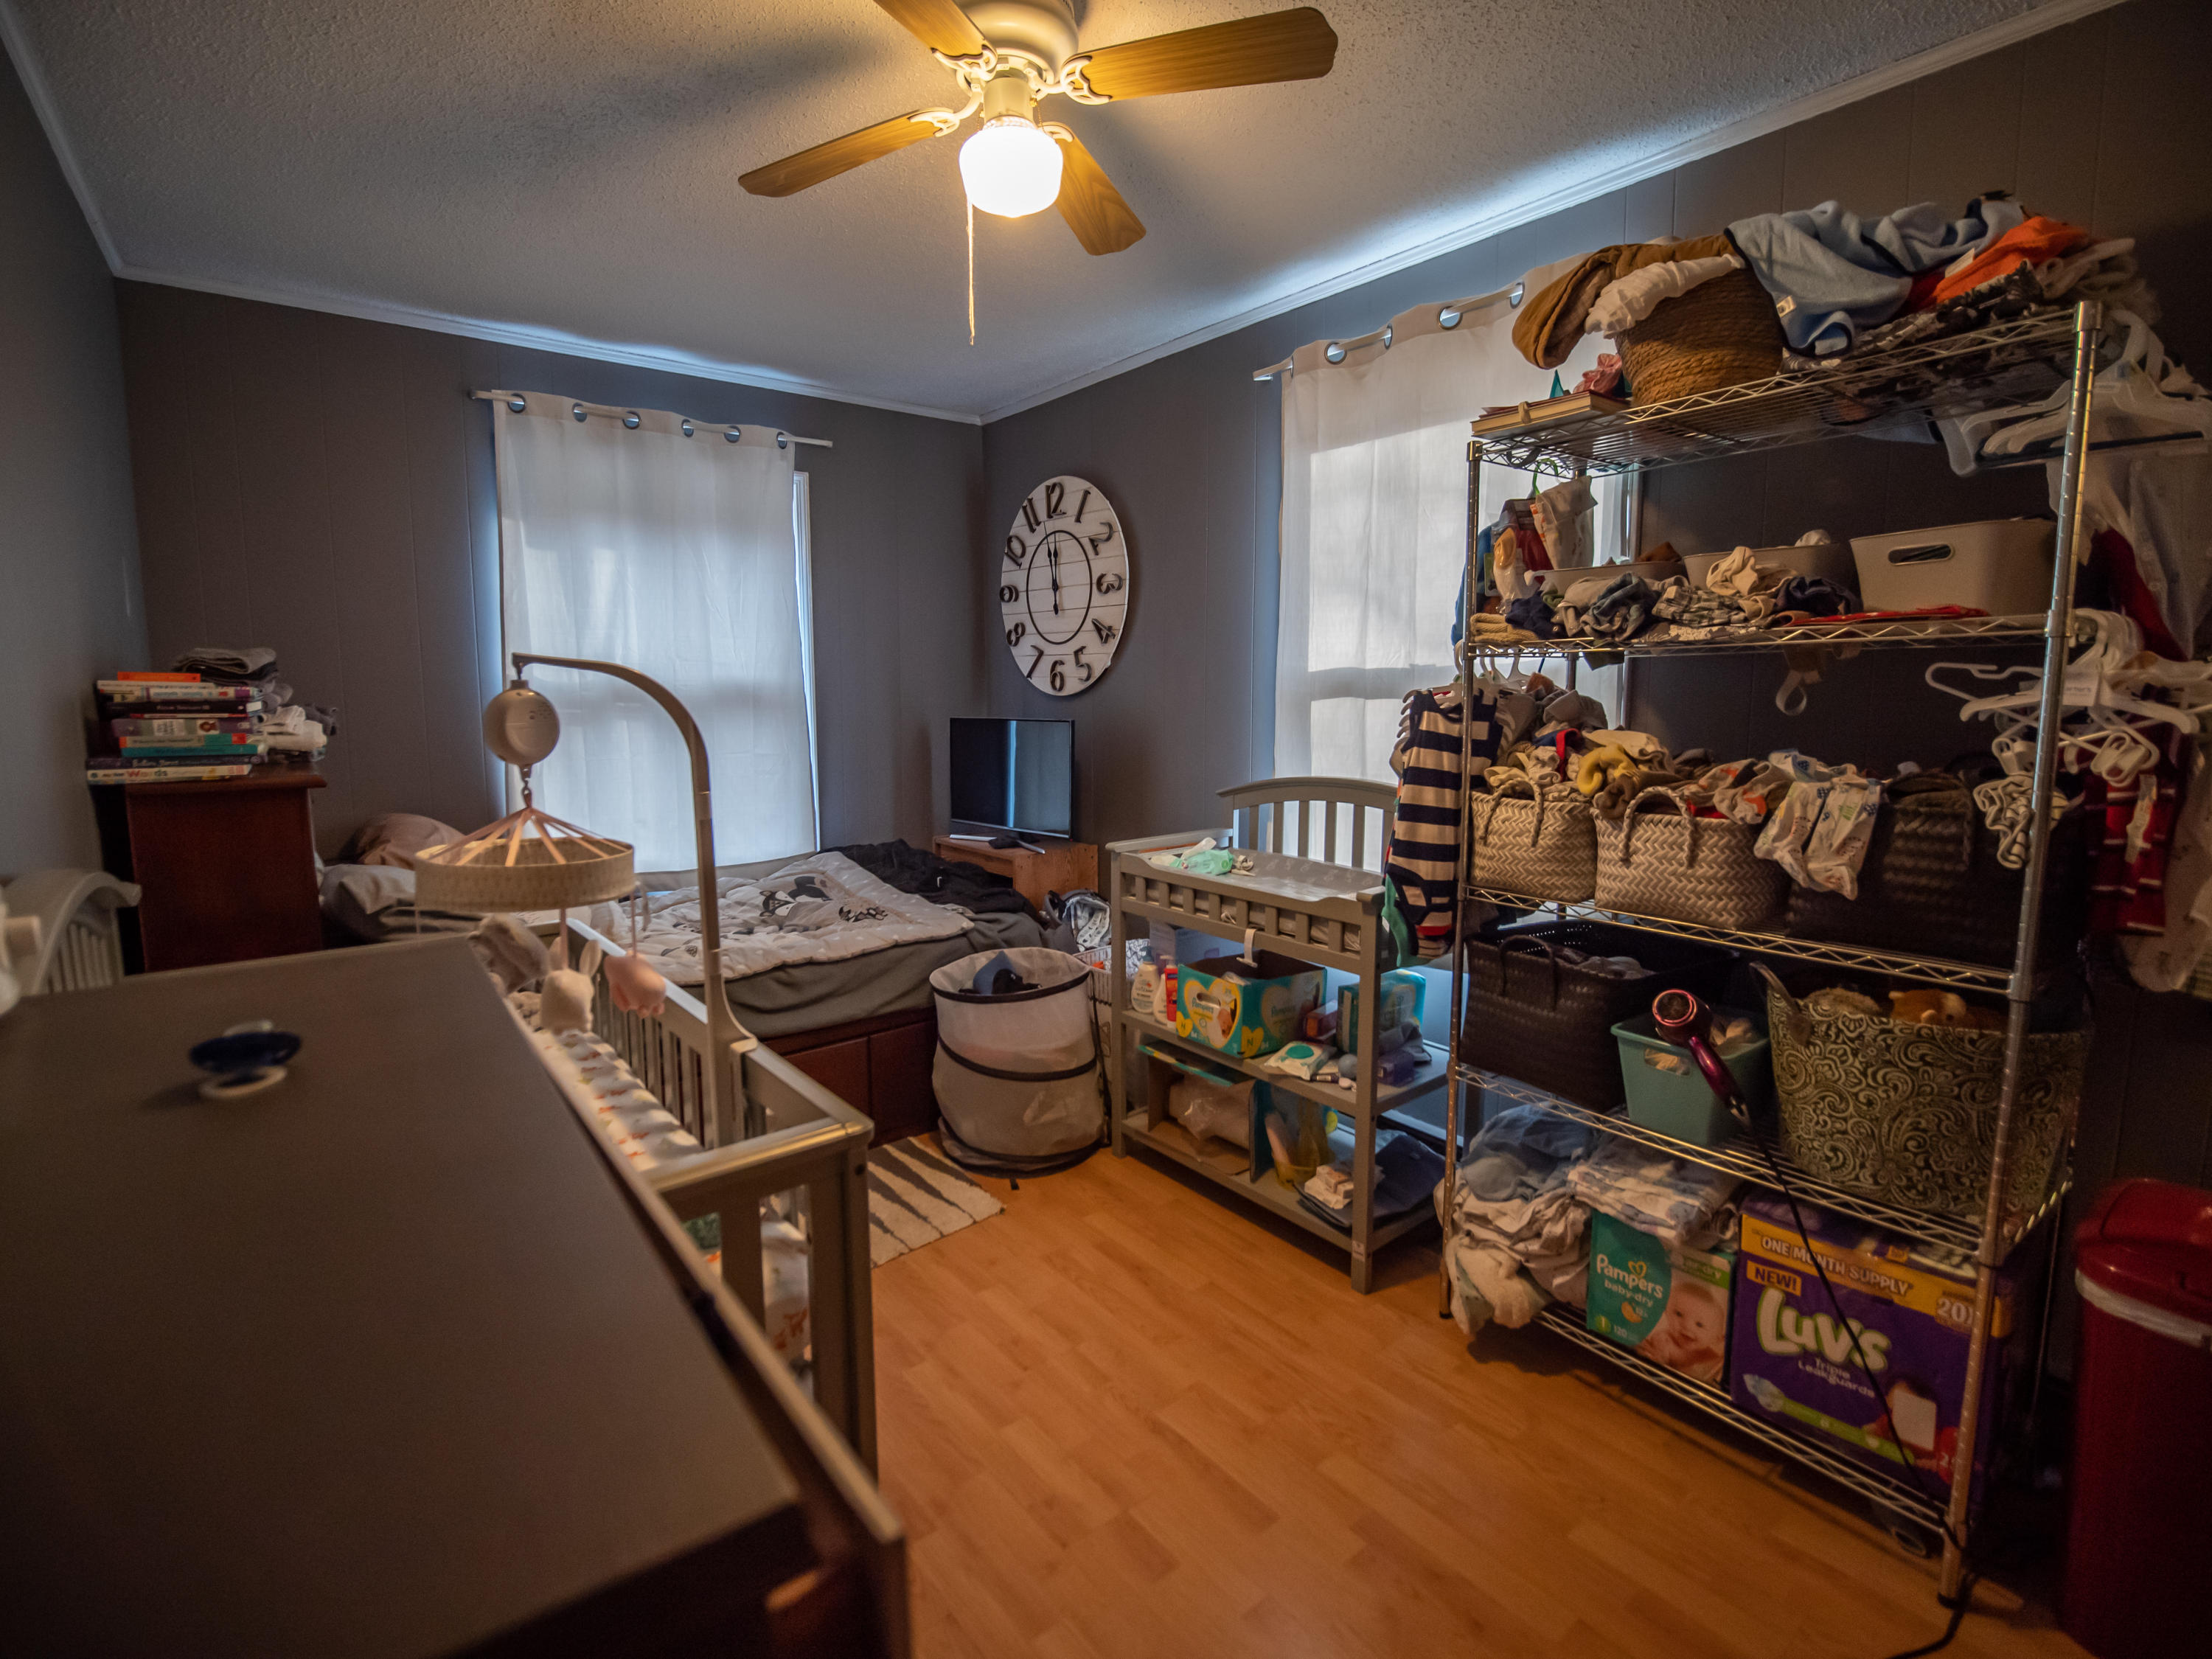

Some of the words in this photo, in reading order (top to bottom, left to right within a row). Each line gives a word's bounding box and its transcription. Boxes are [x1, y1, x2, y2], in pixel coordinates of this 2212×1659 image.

[1022, 497, 1042, 533] 11
[1045, 482, 1067, 518] 12
[1074, 490, 1091, 524] 1
[1005, 535, 1026, 569] 10
[1088, 521, 1113, 556] 2
[999, 585, 1019, 603] 9
[1096, 573, 1123, 594] 3
[1006, 622, 1026, 647] 8
[1091, 618, 1116, 644] 4
[1026, 645, 1044, 679] 7
[1050, 660, 1065, 692] 6
[1074, 646, 1092, 682] 5
[1761, 1236, 1790, 1256] ONE
[1596, 1253, 1663, 1299] Pampers
[1755, 1267, 1798, 1290] NEW!
[1756, 1284, 1893, 1372] Luvs
[1936, 1298, 1975, 1325] 20
